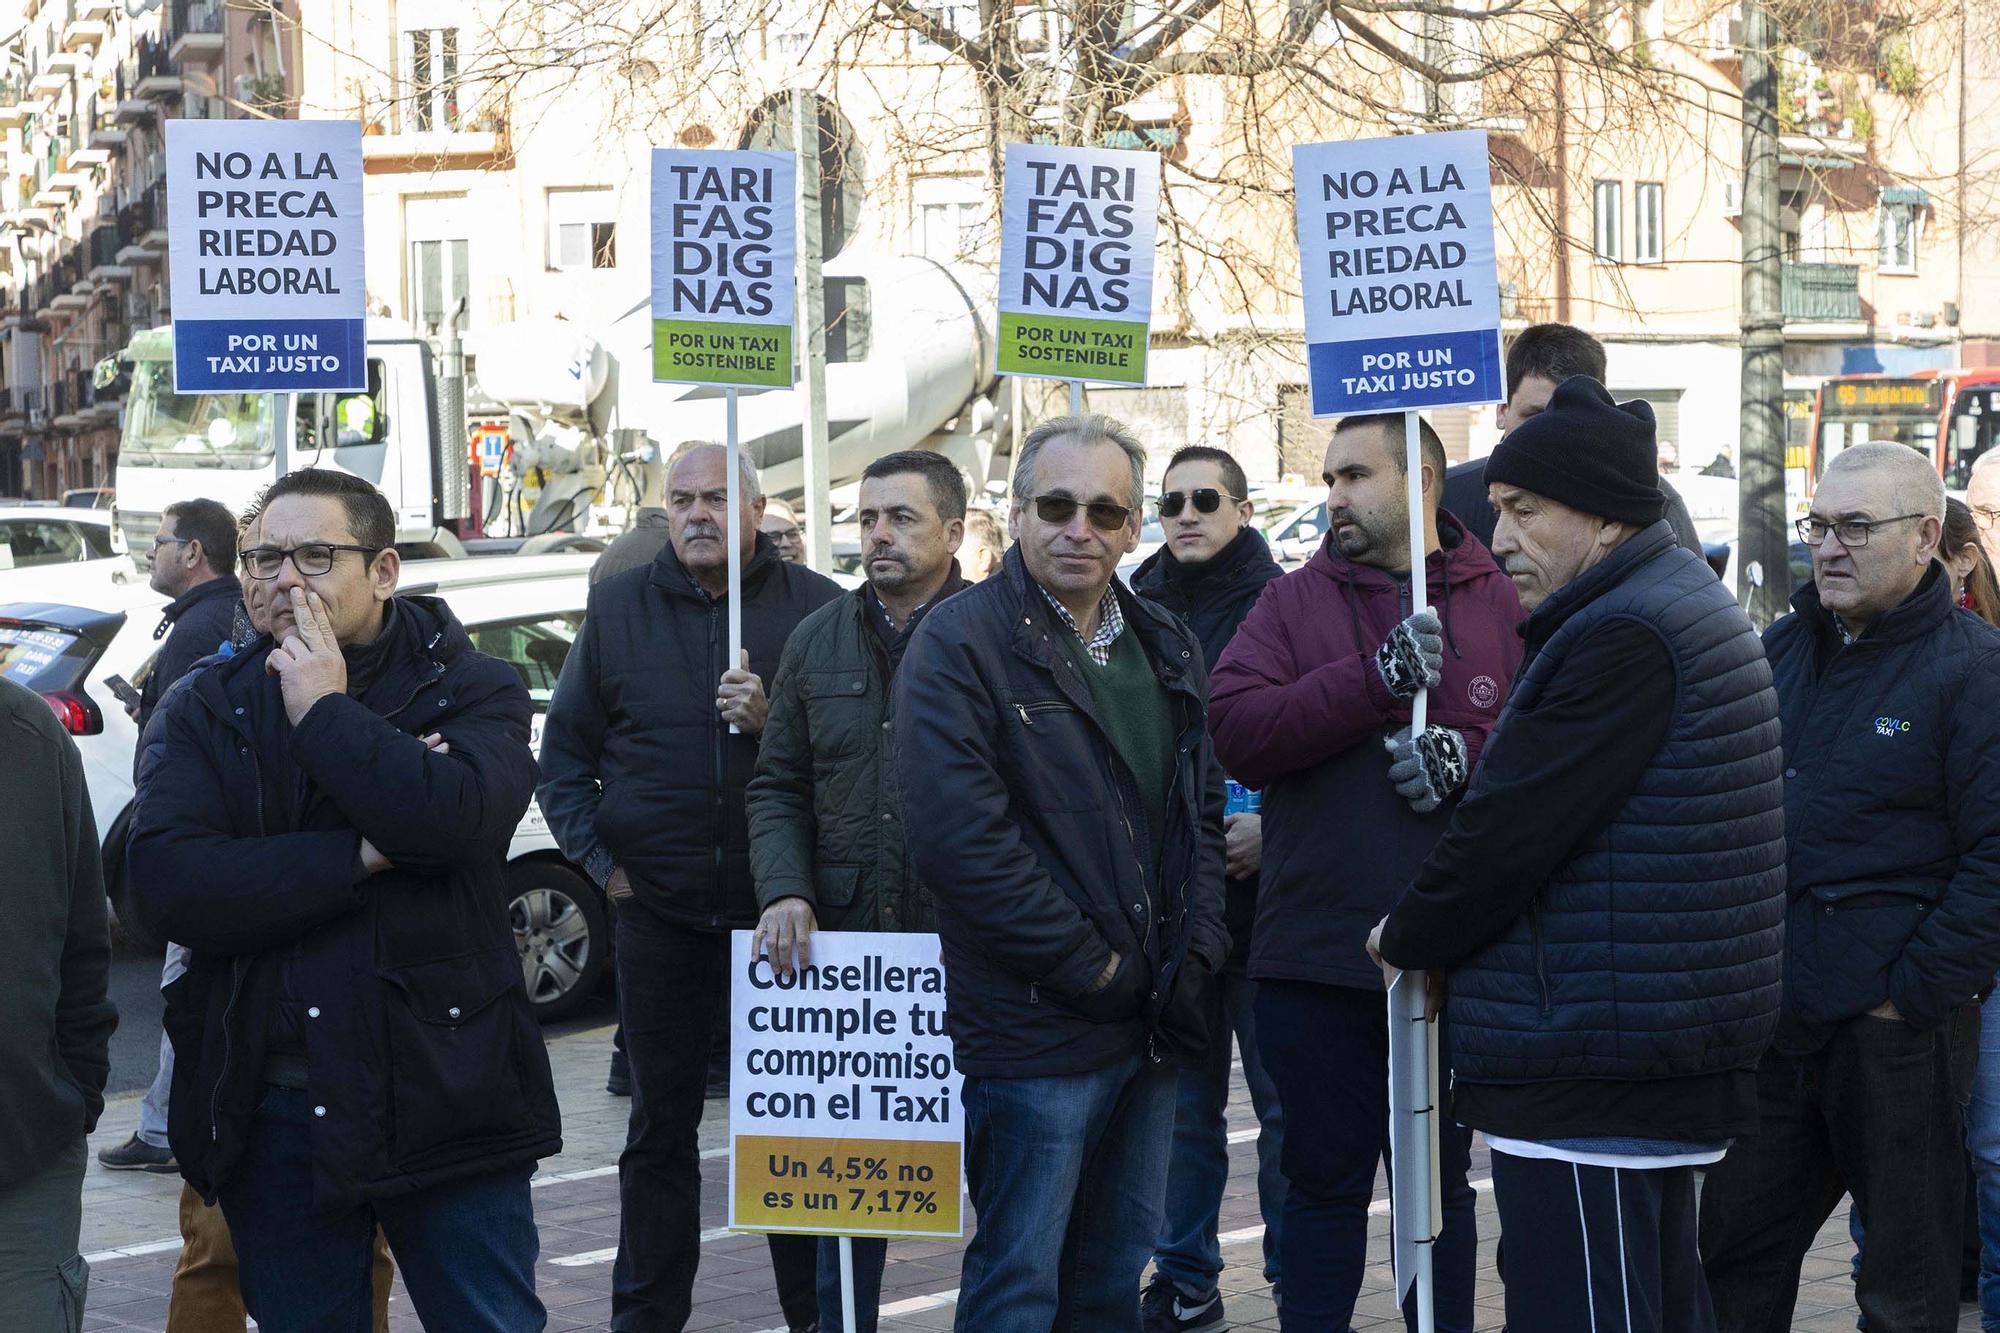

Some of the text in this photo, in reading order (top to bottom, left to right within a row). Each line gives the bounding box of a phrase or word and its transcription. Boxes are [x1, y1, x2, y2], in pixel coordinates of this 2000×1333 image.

[196, 152, 338, 179] NO A LA
[671, 165, 772, 202] TARI
[1026, 161, 1135, 202] TARI
[1323, 164, 1465, 201] NO A LA
[198, 191, 338, 218] PRECA
[673, 204, 773, 240] FAS
[1026, 198, 1133, 238] FAS
[1326, 203, 1466, 239] PRECA
[200, 229, 336, 257] RIEDAD
[674, 241, 773, 278] DIG
[1024, 235, 1131, 275] DIG
[1328, 242, 1466, 278] RIEDAD
[200, 268, 340, 295] LABORAL
[673, 278, 773, 316] NAS
[1022, 272, 1130, 312] NAS
[1331, 280, 1473, 316] LABORAL
[229, 334, 317, 351] POR UN
[669, 332, 778, 353] POR UN TAXI
[1016, 326, 1133, 349] POR UN TAXI
[207, 356, 340, 373] TAXI JUSTO
[672, 352, 776, 372] SOSTENIBLE
[1018, 345, 1129, 368] SOSTENIBLE
[1363, 348, 1451, 371] POR UN
[1342, 369, 1476, 394] TAXI JUSTO
[1876, 726, 1895, 737] TAXI
[748, 954, 947, 1000] Consellera
[748, 999, 949, 1042] cumple tu
[747, 1042, 951, 1084] compromiso
[746, 1084, 950, 1123] con el Taxi
[769, 1155, 934, 1182] Un 4,5% no
[763, 1189, 937, 1215] es un 7,17%
